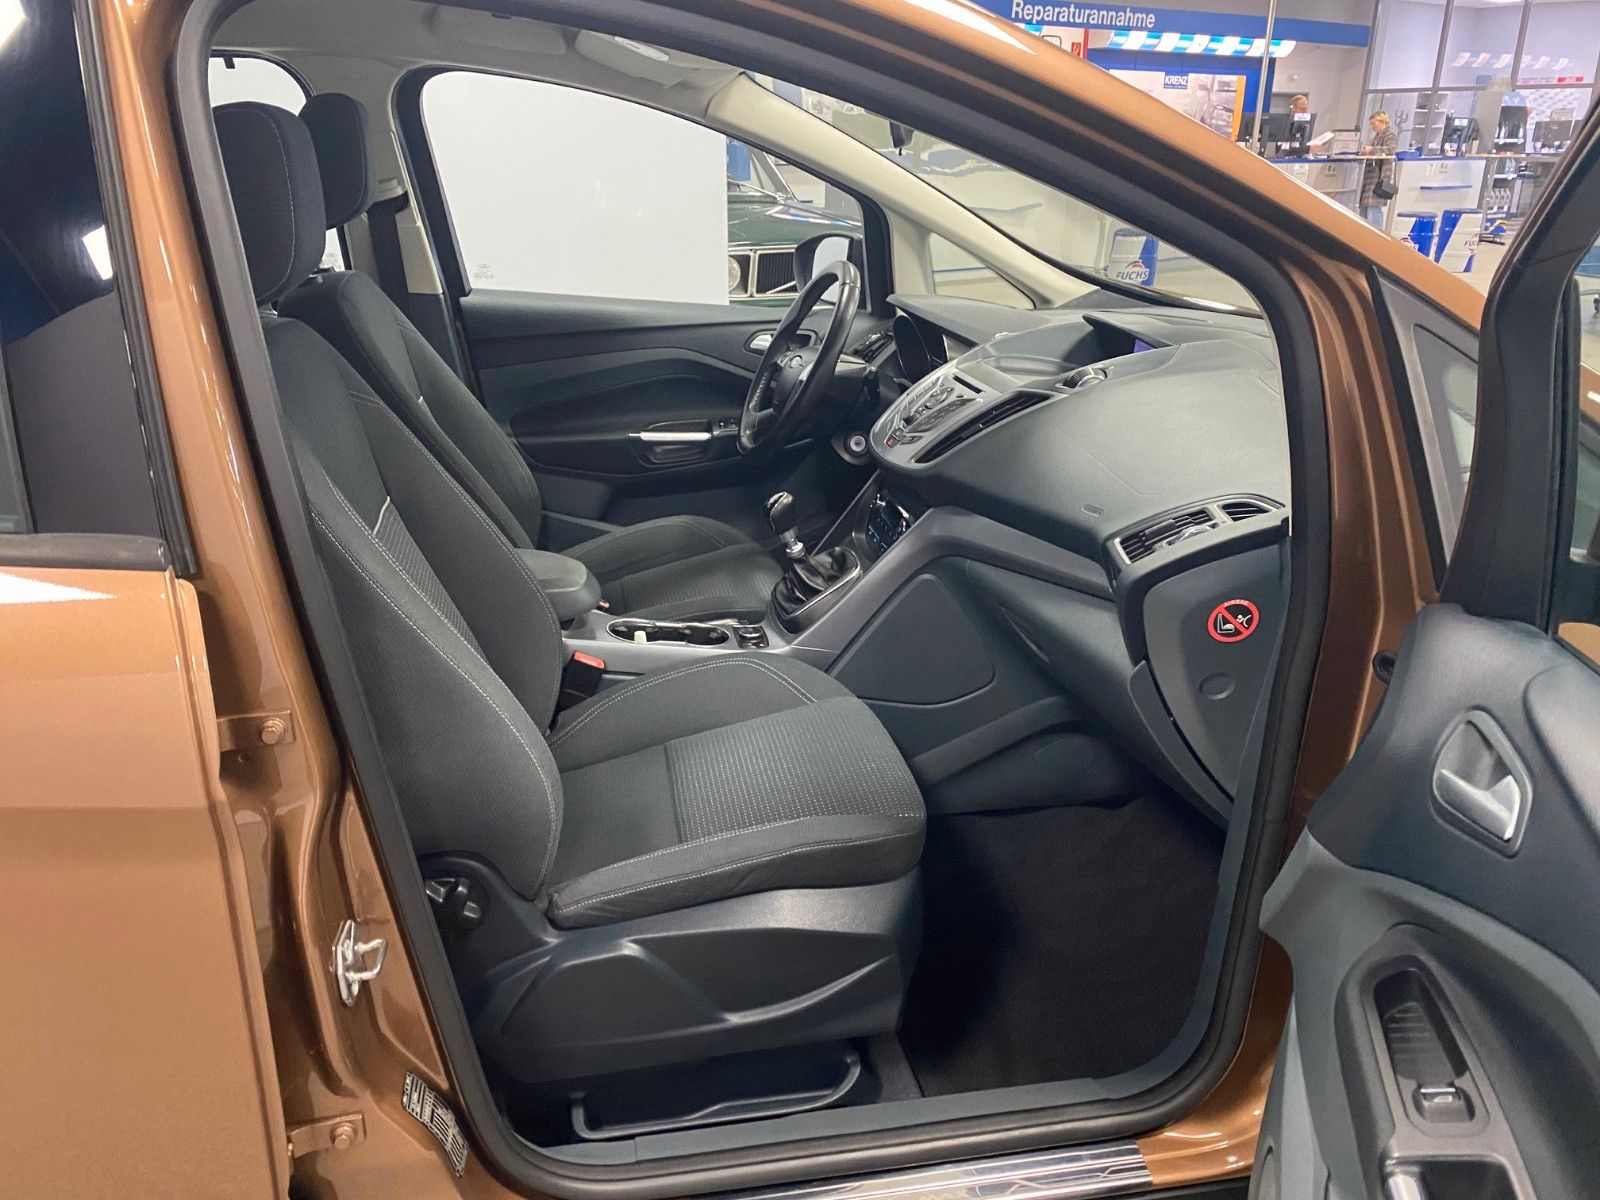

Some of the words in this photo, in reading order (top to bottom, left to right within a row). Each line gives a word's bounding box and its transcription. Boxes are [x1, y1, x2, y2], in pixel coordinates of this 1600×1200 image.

[1011, 0, 1155, 28] Reparaturannahme
[1165, 75, 1188, 85] KRENZ
[1116, 269, 1149, 280] FUCHS
